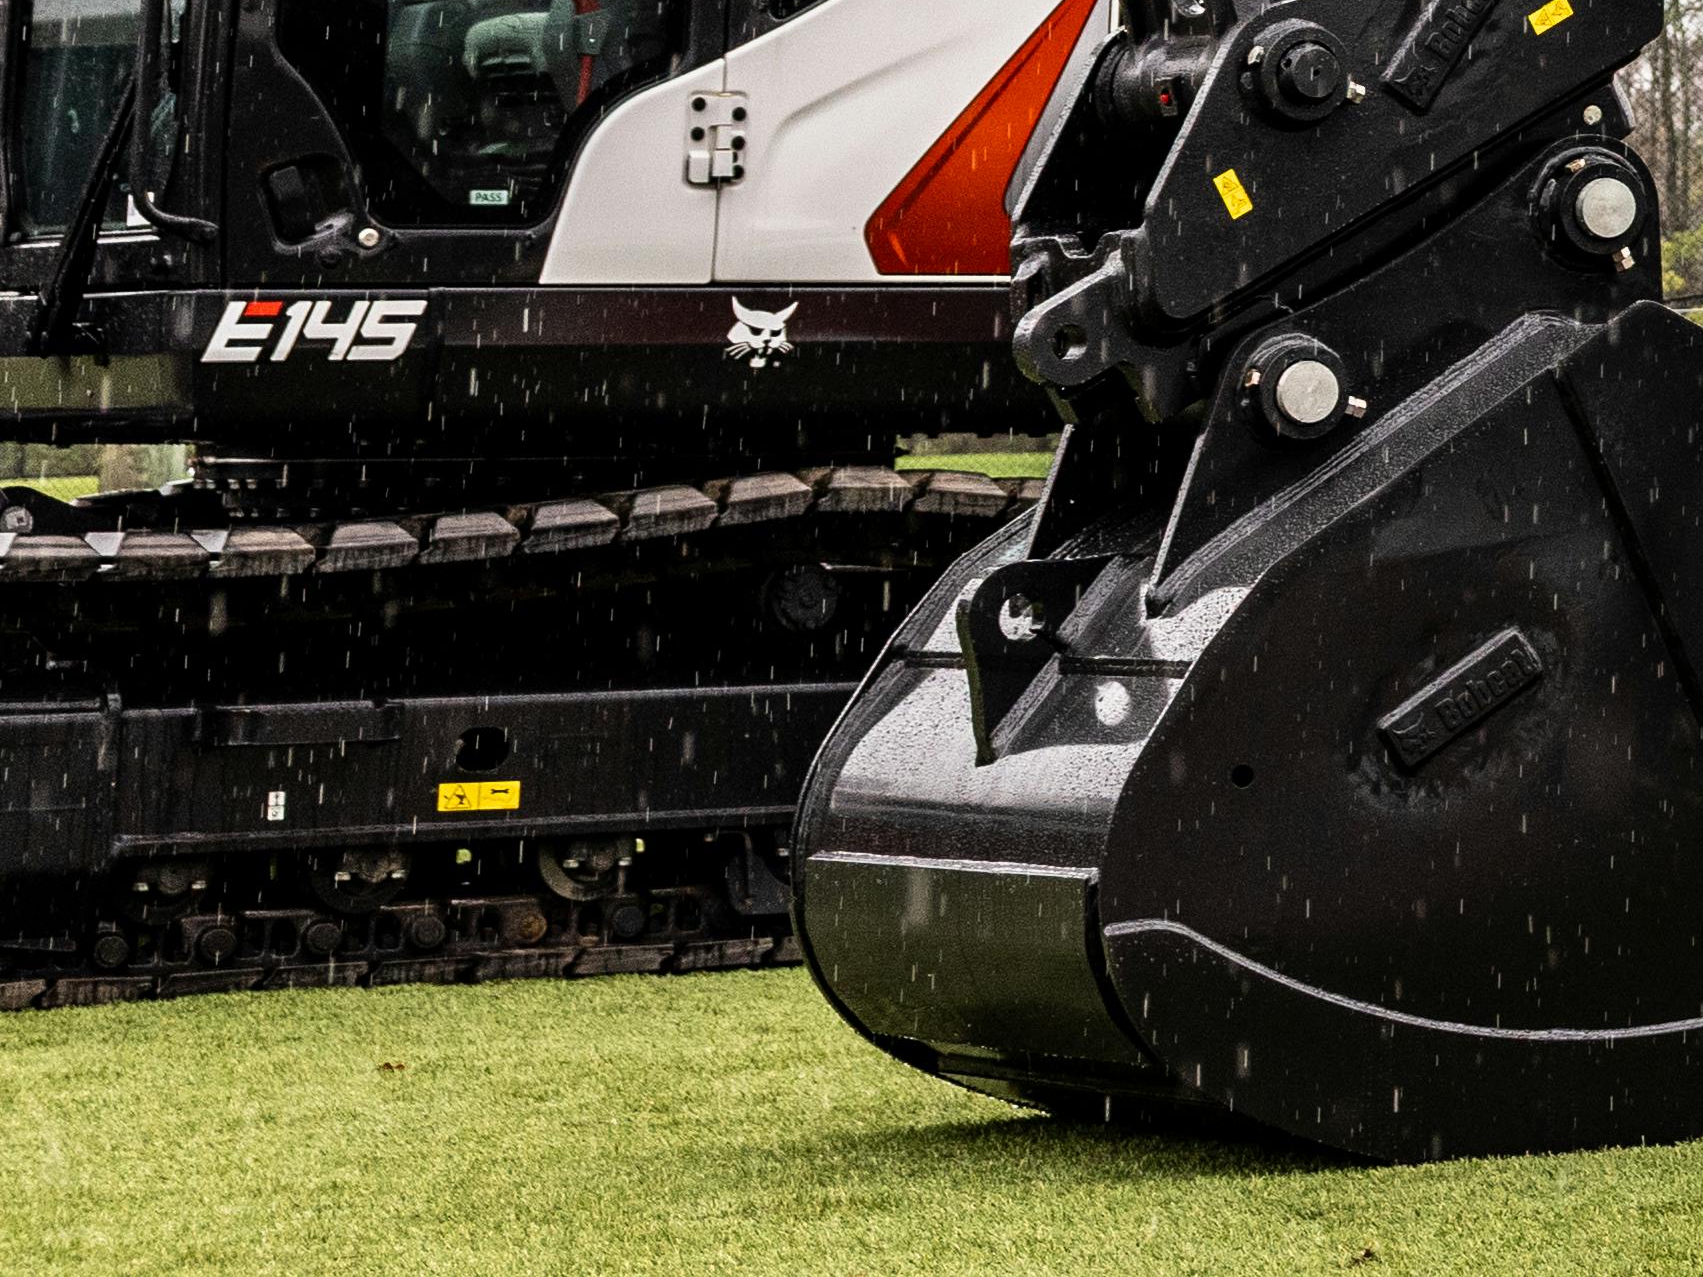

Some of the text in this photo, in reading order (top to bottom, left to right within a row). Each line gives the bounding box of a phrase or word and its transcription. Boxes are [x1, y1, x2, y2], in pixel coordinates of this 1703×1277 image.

[475, 193, 502, 202] PASS
[200, 300, 428, 362] E145
[1435, 649, 1534, 731] Bobcat
